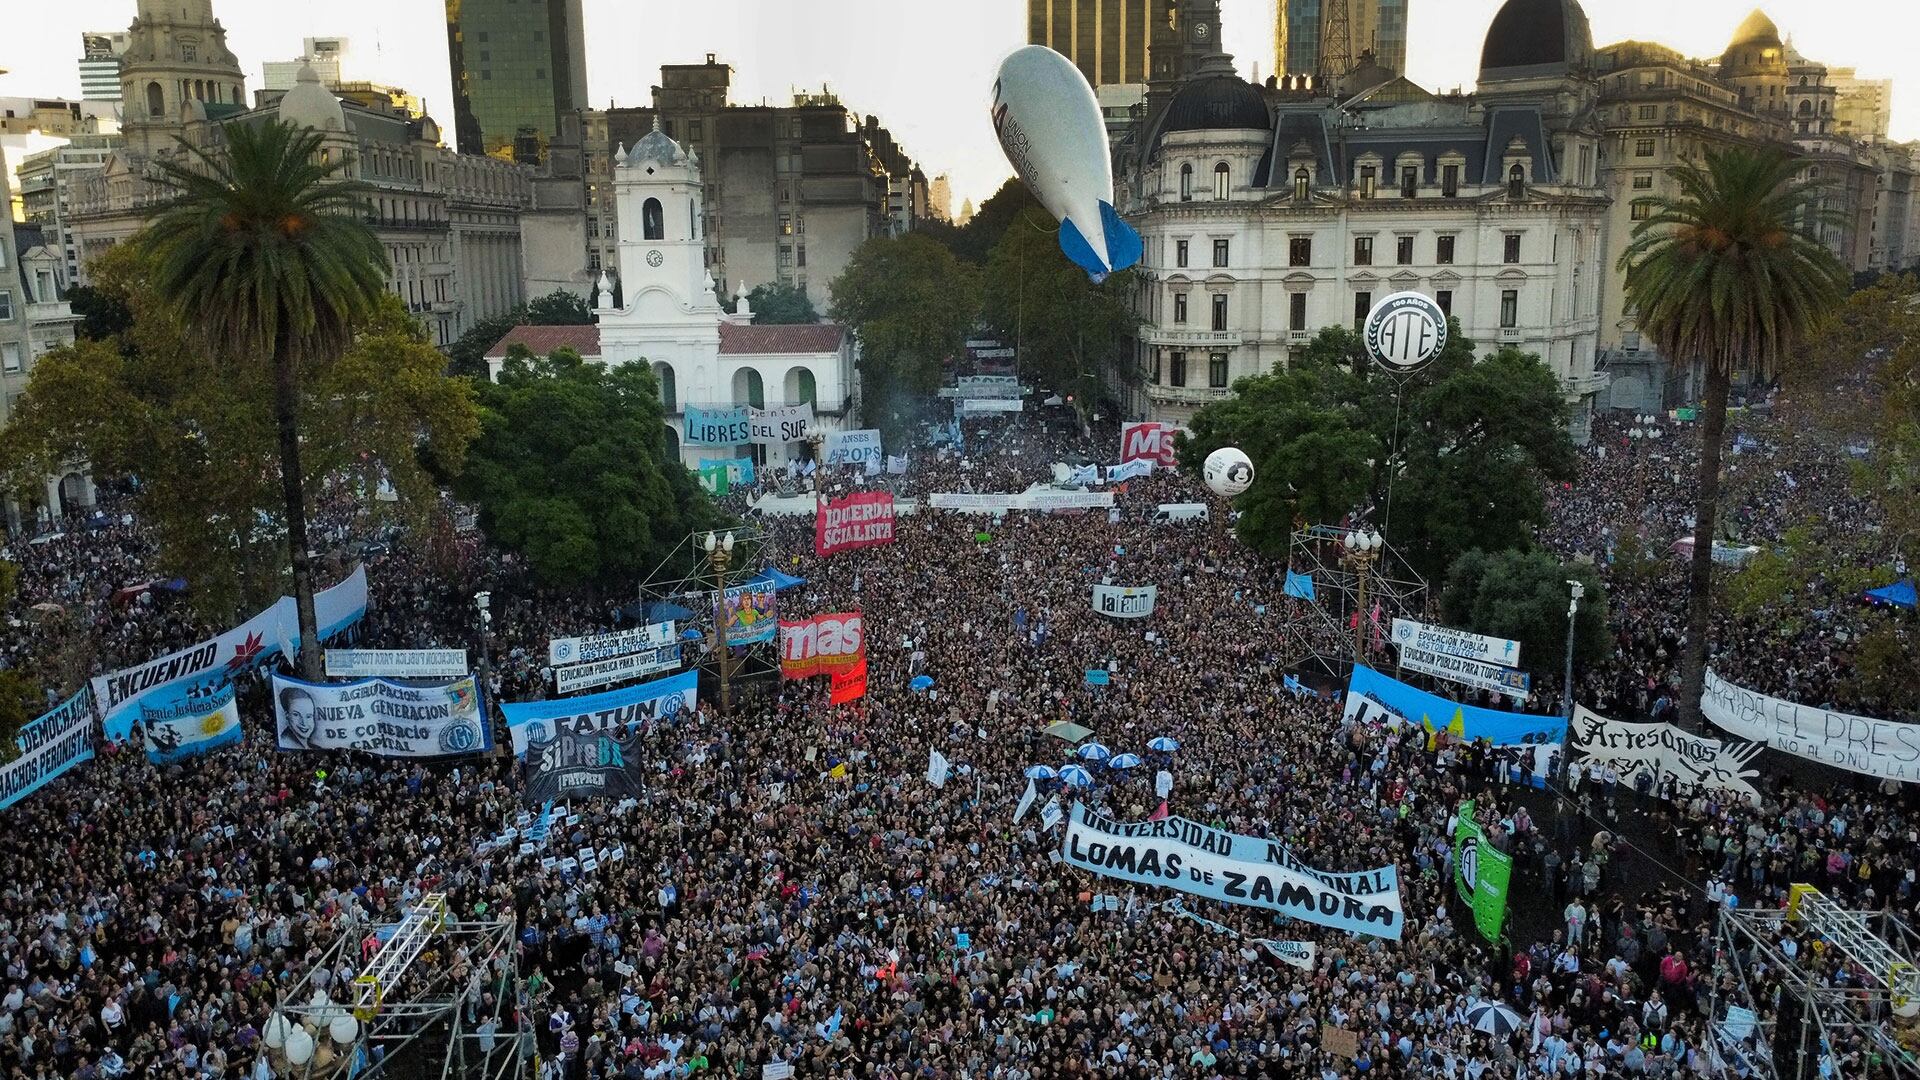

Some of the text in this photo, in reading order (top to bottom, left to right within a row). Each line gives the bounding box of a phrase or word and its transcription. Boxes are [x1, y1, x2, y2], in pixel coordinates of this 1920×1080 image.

[1008, 116, 1032, 153] UNION
[1003, 127, 1039, 181] DOCENTES
[1392, 299, 1428, 309] 100 AÑOS
[1381, 311, 1432, 360] ATE
[689, 419, 806, 443] LIBRES DEL SUR
[842, 434, 869, 443] ANSES
[1417, 640, 1475, 658] GASTON FRUTOS
[1418, 631, 1489, 653] EDUCACION PUBLICA
[107, 642, 218, 707] ENCUENTRO
[1437, 654, 1461, 672] PUBLICA
[1462, 660, 1478, 676] PARA
[1481, 665, 1502, 681] TODOS
[22, 687, 92, 755] DEMOCRACIA
[316, 700, 449, 722] NUEVA GENERACION
[554, 699, 658, 732] FATUN
[1776, 703, 1807, 739] EL
[325, 723, 430, 740] DE COMERCIO
[350, 737, 415, 752] CAPITAL
[1582, 716, 1717, 763] Artesanos
[1778, 737, 1798, 753] NO
[1807, 745, 1823, 759] AL
[1834, 750, 1877, 774] DNU,
[1887, 761, 1904, 777] LA
[1082, 811, 1233, 857] UNIVERSIDAD
[1070, 833, 1394, 927] LOMAS DE ZAMORA
